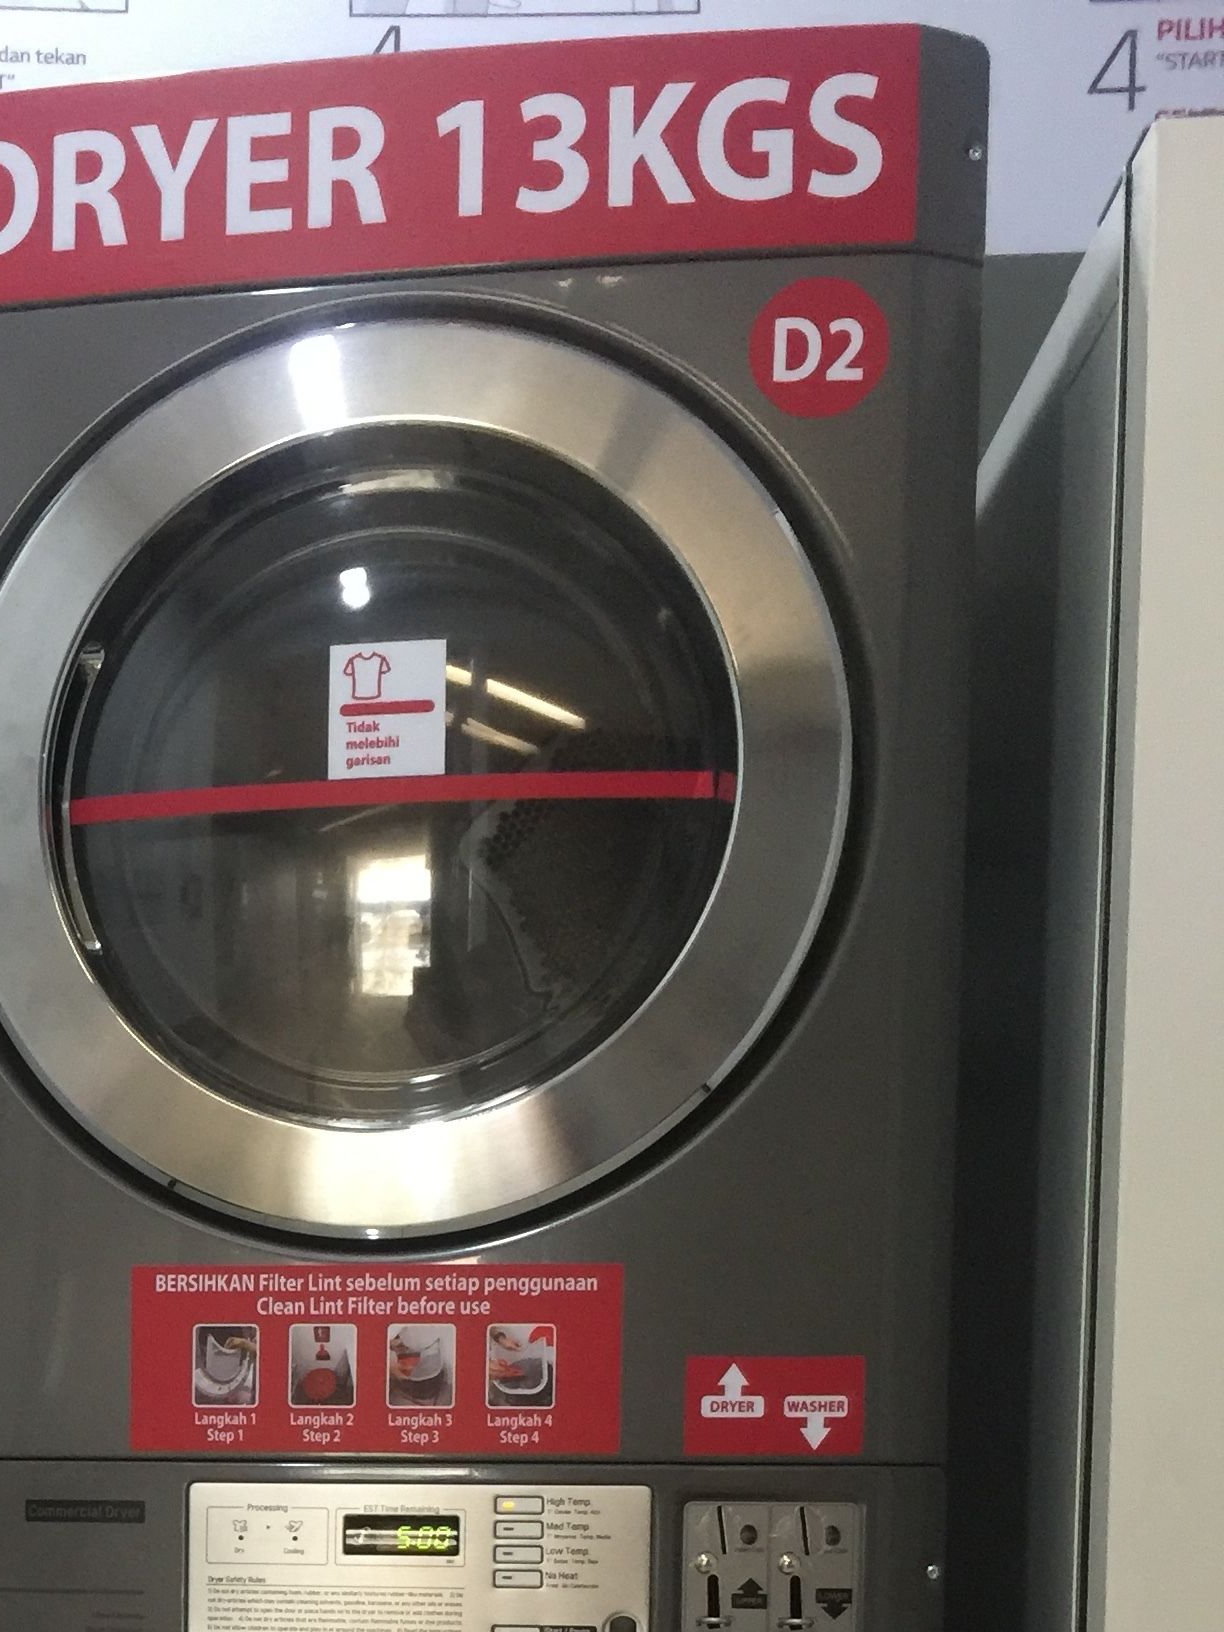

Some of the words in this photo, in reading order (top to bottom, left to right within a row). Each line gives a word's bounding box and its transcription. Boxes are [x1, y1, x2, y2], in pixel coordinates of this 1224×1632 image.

[36, 48, 87, 65] tekan
[1088, 29, 1147, 111] 4
[435, 72, 883, 217] 13KGS
[773, 316, 864, 382] D2
[346, 721, 380, 733] Tidak
[346, 735, 399, 750] melebihi
[346, 753, 391, 769] garisan
[155, 1273, 254, 1293] BERSIHKAN
[259, 1273, 304, 1292] Filter
[308, 1273, 342, 1292] Lint
[345, 1273, 421, 1292] sebelum
[425, 1274, 479, 1296] setiap
[483, 1277, 598, 1296] penggunaan
[256, 1296, 305, 1315] Clean
[309, 1296, 343, 1315] Lint
[346, 1296, 393, 1315] Filter
[397, 1296, 456, 1315] before
[460, 1301, 490, 1316] use
[710, 1400, 755, 1413] DRYER
[787, 1400, 845, 1412] WASHER
[194, 1413, 247, 1428] Langkah
[251, 1413, 257, 1426] 1
[290, 1413, 342, 1428] Langkah
[346, 1413, 354, 1426] 2
[388, 1413, 440, 1428] Langkah
[444, 1413, 453, 1426] 3
[487, 1413, 540, 1428] Langkah
[544, 1413, 553, 1427] 4
[207, 1429, 235, 1443] Step
[238, 1429, 244, 1441] 1
[303, 1429, 330, 1443] Step
[333, 1429, 341, 1442] 2
[401, 1429, 428, 1444] Step
[431, 1429, 439, 1442] 3
[500, 1430, 527, 1444] Step
[530, 1430, 539, 1443] 4
[28, 1503, 102, 1518] Commercial
[106, 1505, 141, 1518] Dryer
[247, 1504, 288, 1513] Processing
